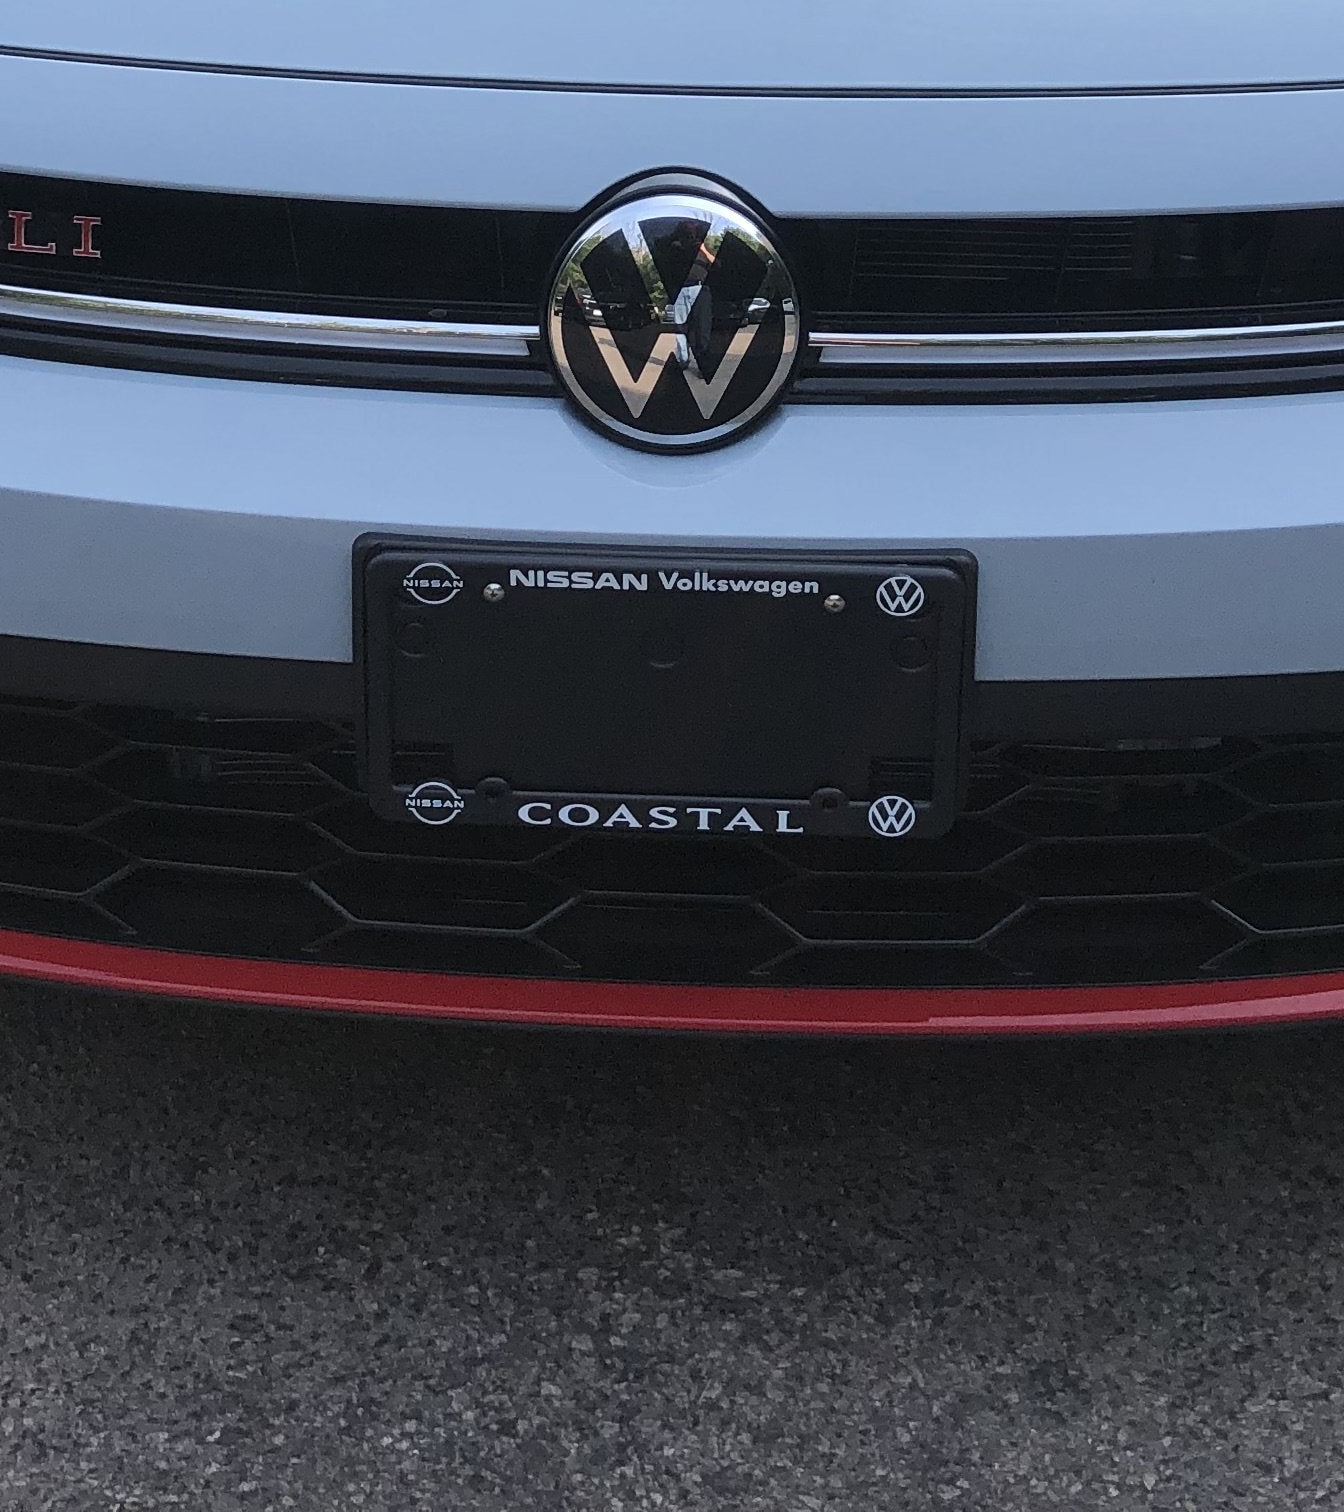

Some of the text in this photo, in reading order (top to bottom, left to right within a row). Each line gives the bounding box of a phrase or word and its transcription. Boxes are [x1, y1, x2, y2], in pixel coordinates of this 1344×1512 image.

[559, 204, 782, 428] VW
[509, 569, 820, 598] NISSAN Volkswagen
[876, 576, 924, 616] VW
[517, 802, 804, 834] COASTAL
[868, 795, 916, 837] VW
